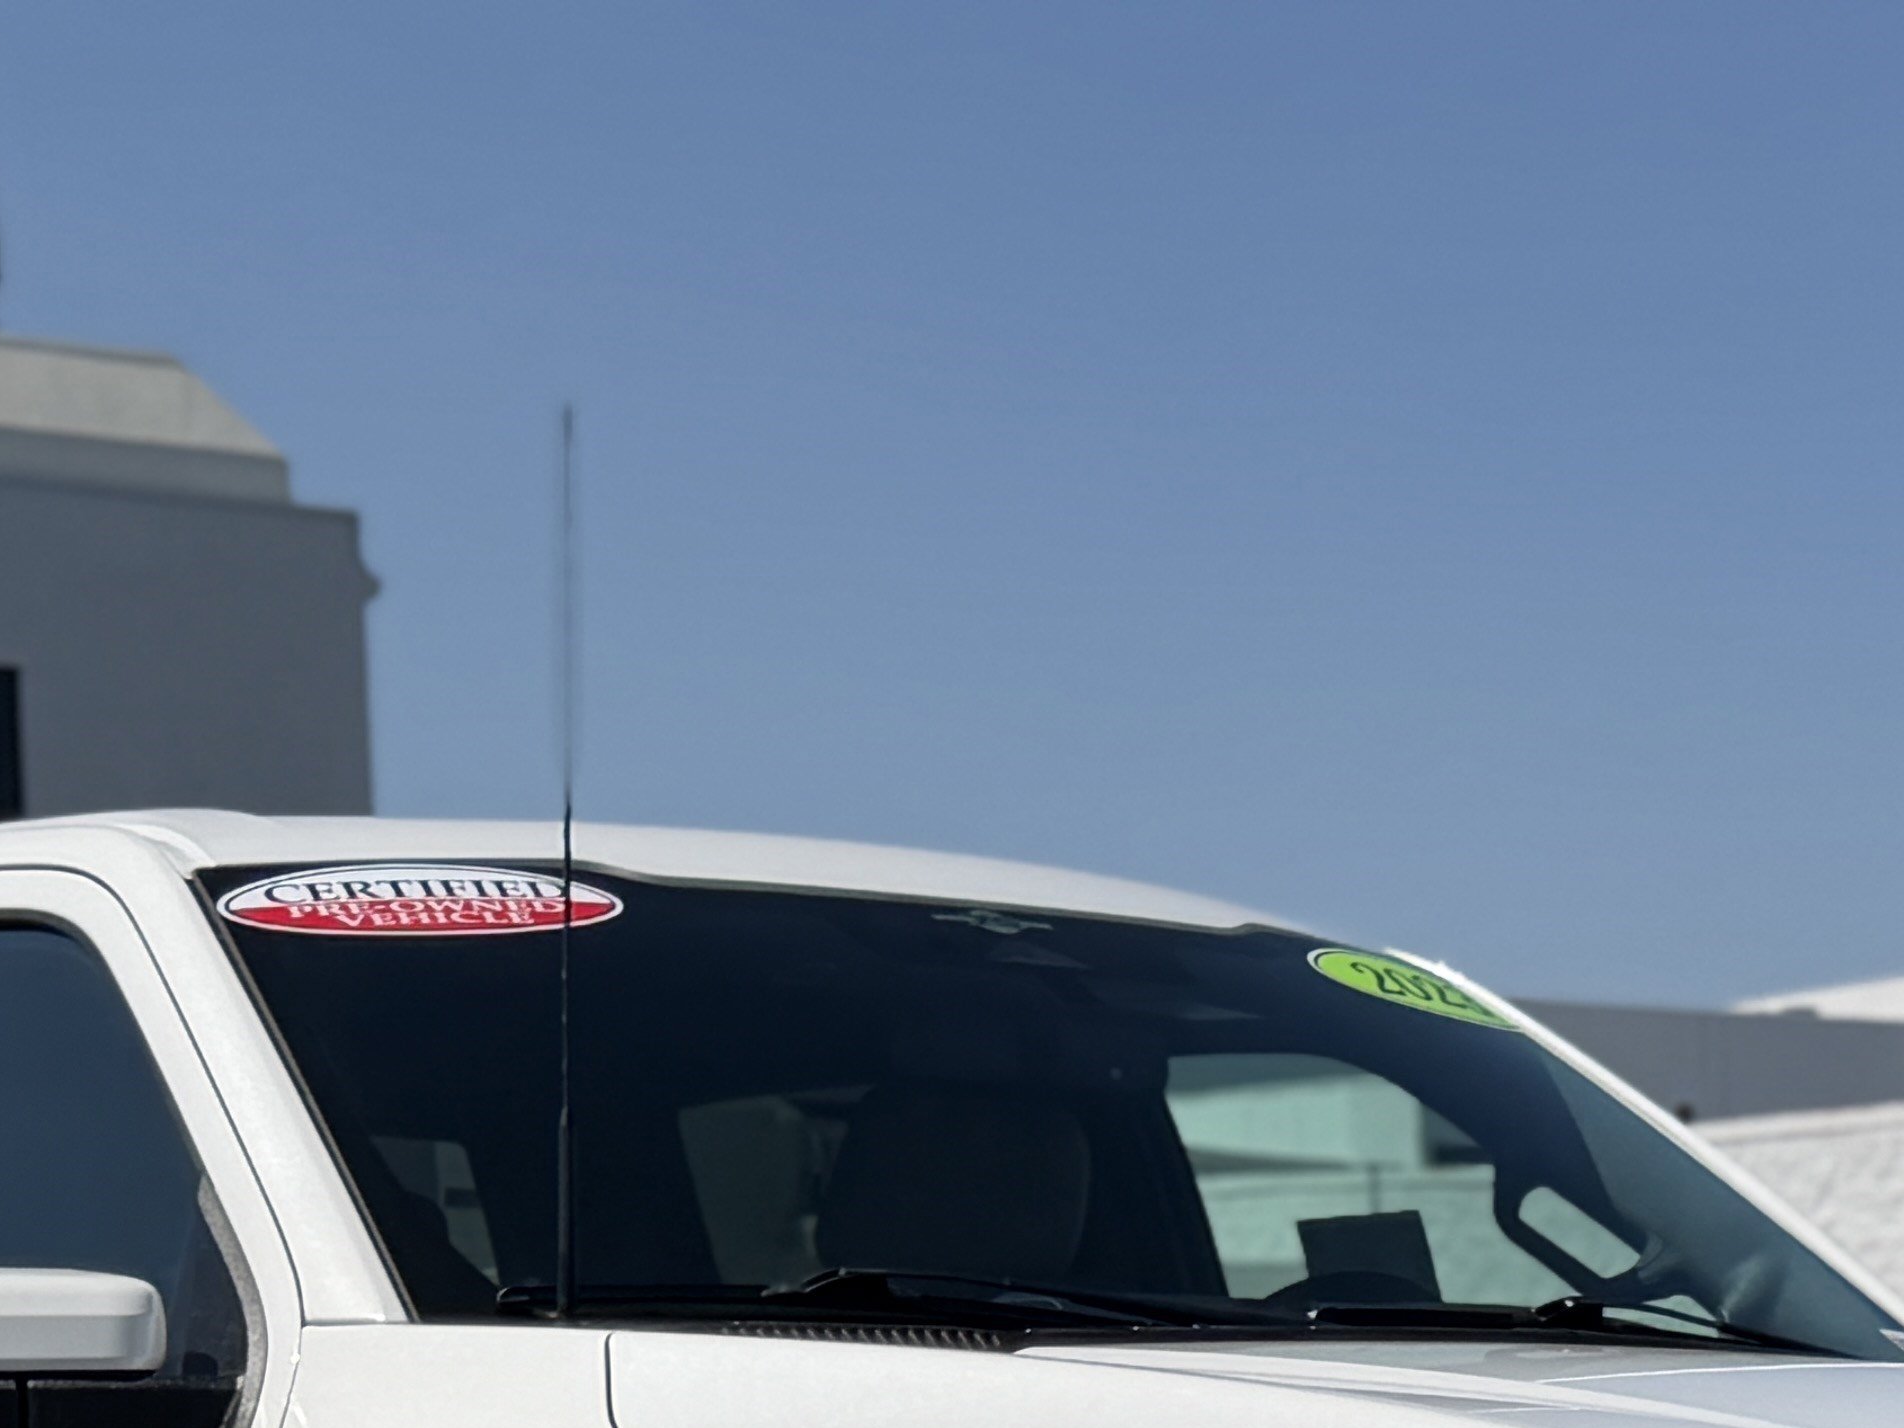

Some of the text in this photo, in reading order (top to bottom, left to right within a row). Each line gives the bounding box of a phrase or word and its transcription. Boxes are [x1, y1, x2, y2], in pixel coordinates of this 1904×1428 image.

[264, 879, 566, 903] CERTIFIED
[285, 898, 566, 919] PRE-OWNED
[333, 909, 536, 928] VEHICLE
